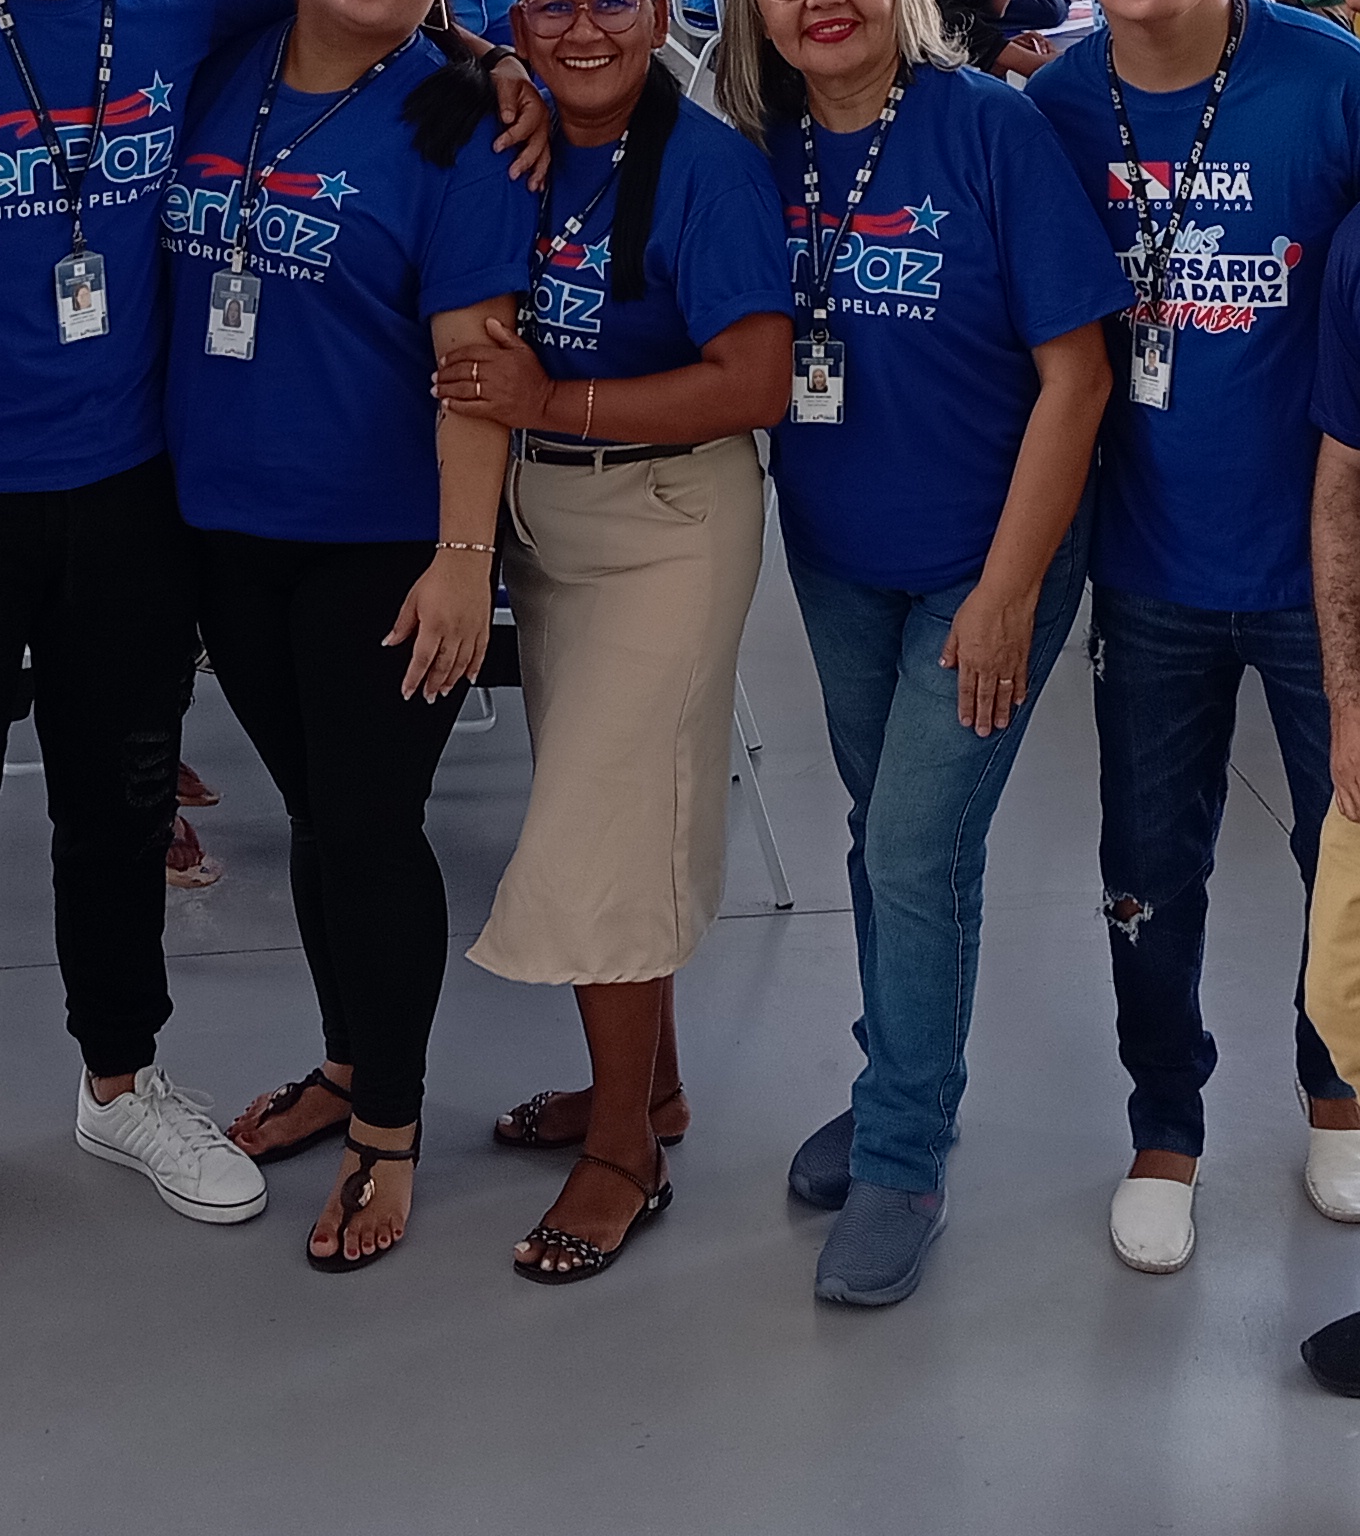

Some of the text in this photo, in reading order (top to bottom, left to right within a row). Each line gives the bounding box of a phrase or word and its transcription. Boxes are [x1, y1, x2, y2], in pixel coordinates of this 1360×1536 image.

[1213, 70, 1227, 93] FCP
[1201, 105, 1215, 129] FCP
[1191, 141, 1203, 164] FCP
[1234, 162, 1251, 171] DO
[89, 188, 138, 209] PELA
[1180, 176, 1192, 200] FCP
[1168, 212, 1181, 235] FCP
[250, 254, 288, 277] PELA
[290, 264, 326, 283] PAZ
[1192, 284, 1227, 302] DA
[1232, 284, 1283, 303] PAZ
[842, 298, 890, 316] PELA
[897, 303, 936, 321] PAZ
[559, 335, 598, 350] PAZ
